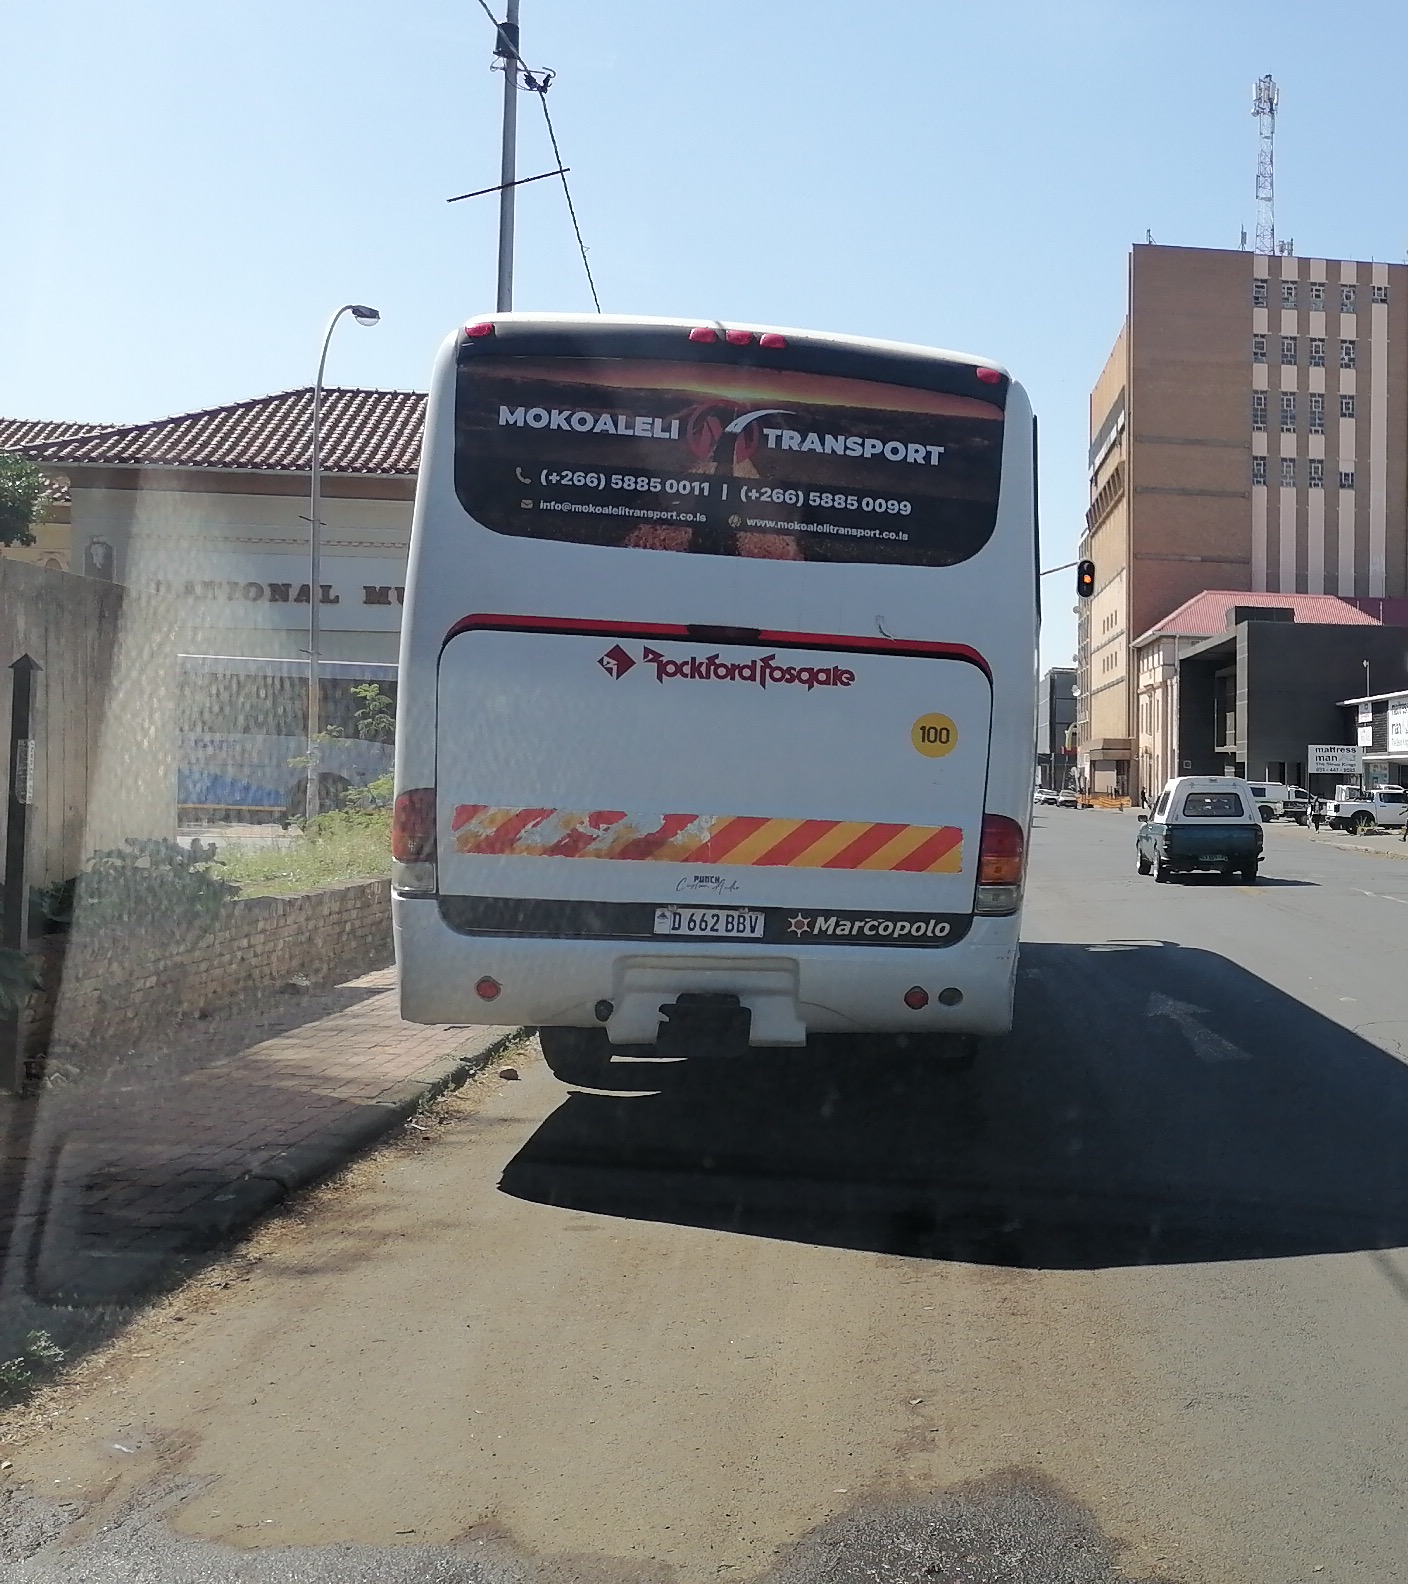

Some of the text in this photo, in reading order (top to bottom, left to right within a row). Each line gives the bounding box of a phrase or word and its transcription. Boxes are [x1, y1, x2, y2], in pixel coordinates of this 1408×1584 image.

[498, 405, 945, 466] MOKOALELI TRANSPORT
[540, 468, 606, 490] (+266)
[610, 474, 662, 493] 5885
[665, 480, 710, 497] 0011
[740, 485, 804, 507] (+266)
[809, 492, 858, 510] 5885
[861, 497, 912, 516] 0099
[539, 499, 707, 523] info@mokoalelitransport.co.ls
[746, 516, 909, 542] www.mokoalelitransport.co.ls
[643, 645, 757, 684] Rockford
[919, 725, 951, 745] 100
[671, 912, 759, 934] D 662 BBV
[812, 915, 951, 938] Marcopolo
